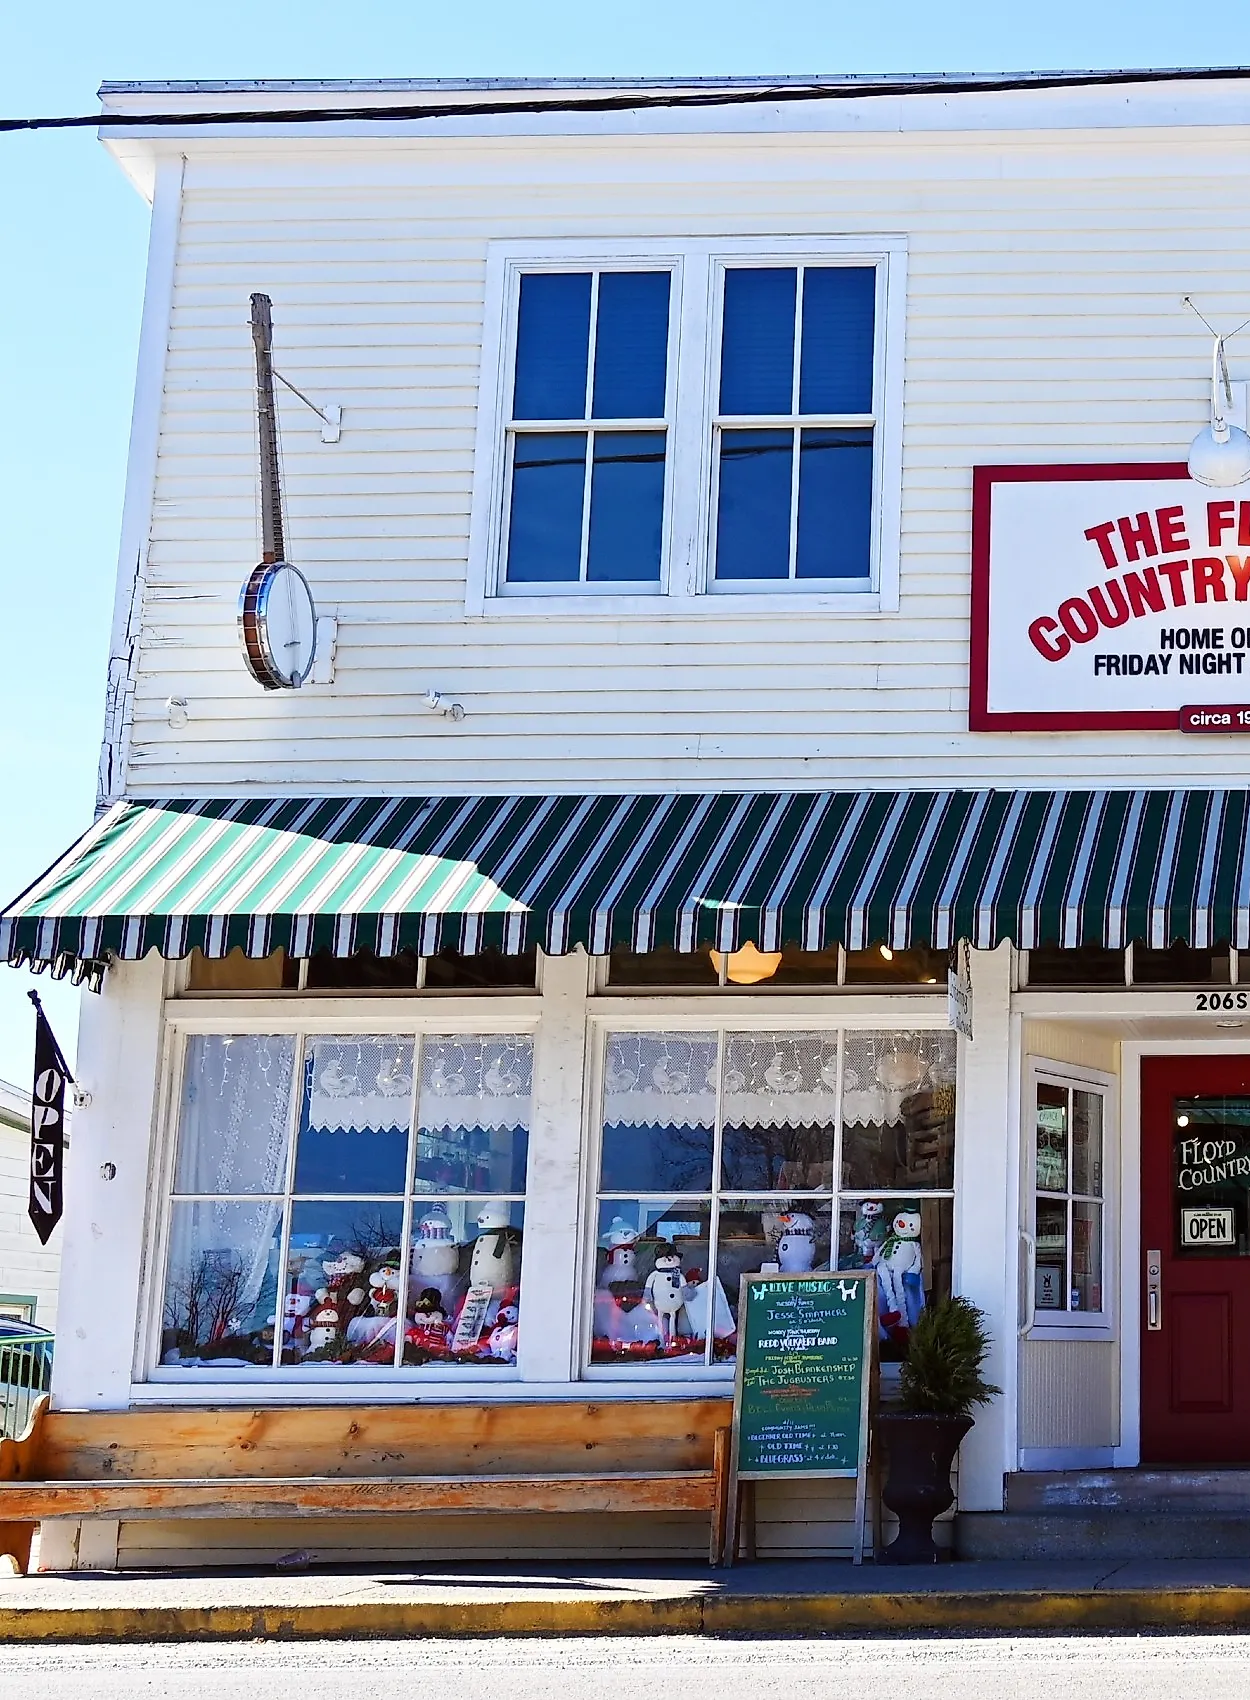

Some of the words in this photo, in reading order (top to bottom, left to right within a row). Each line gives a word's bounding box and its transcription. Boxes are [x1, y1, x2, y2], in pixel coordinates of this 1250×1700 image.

[1084, 505, 1191, 570] THE
[1160, 628, 1224, 650] HOME
[1094, 653, 1173, 676] FRIDAY
[1179, 652, 1246, 675] NIGHT
[1189, 711, 1231, 726] circa
[32, 1067, 62, 1215] OPEN
[1180, 1138, 1236, 1165] FLOYD
[1189, 1217, 1227, 1240] OPEN
[769, 1281, 794, 1292] LIVE
[766, 1309, 796, 1320] JESSE
[798, 1307, 848, 1319] SMATHERS
[758, 1339, 780, 1349] REDD
[817, 1336, 838, 1346] BAND
[771, 1365, 794, 1375] JOSH
[794, 1363, 856, 1375] BLANKENSHIP
[755, 1375, 775, 1387] THE
[776, 1374, 835, 1386] JUGBUSTERS
[767, 1442, 782, 1450] OLD
[760, 1454, 804, 1464] BLUEGRASS
